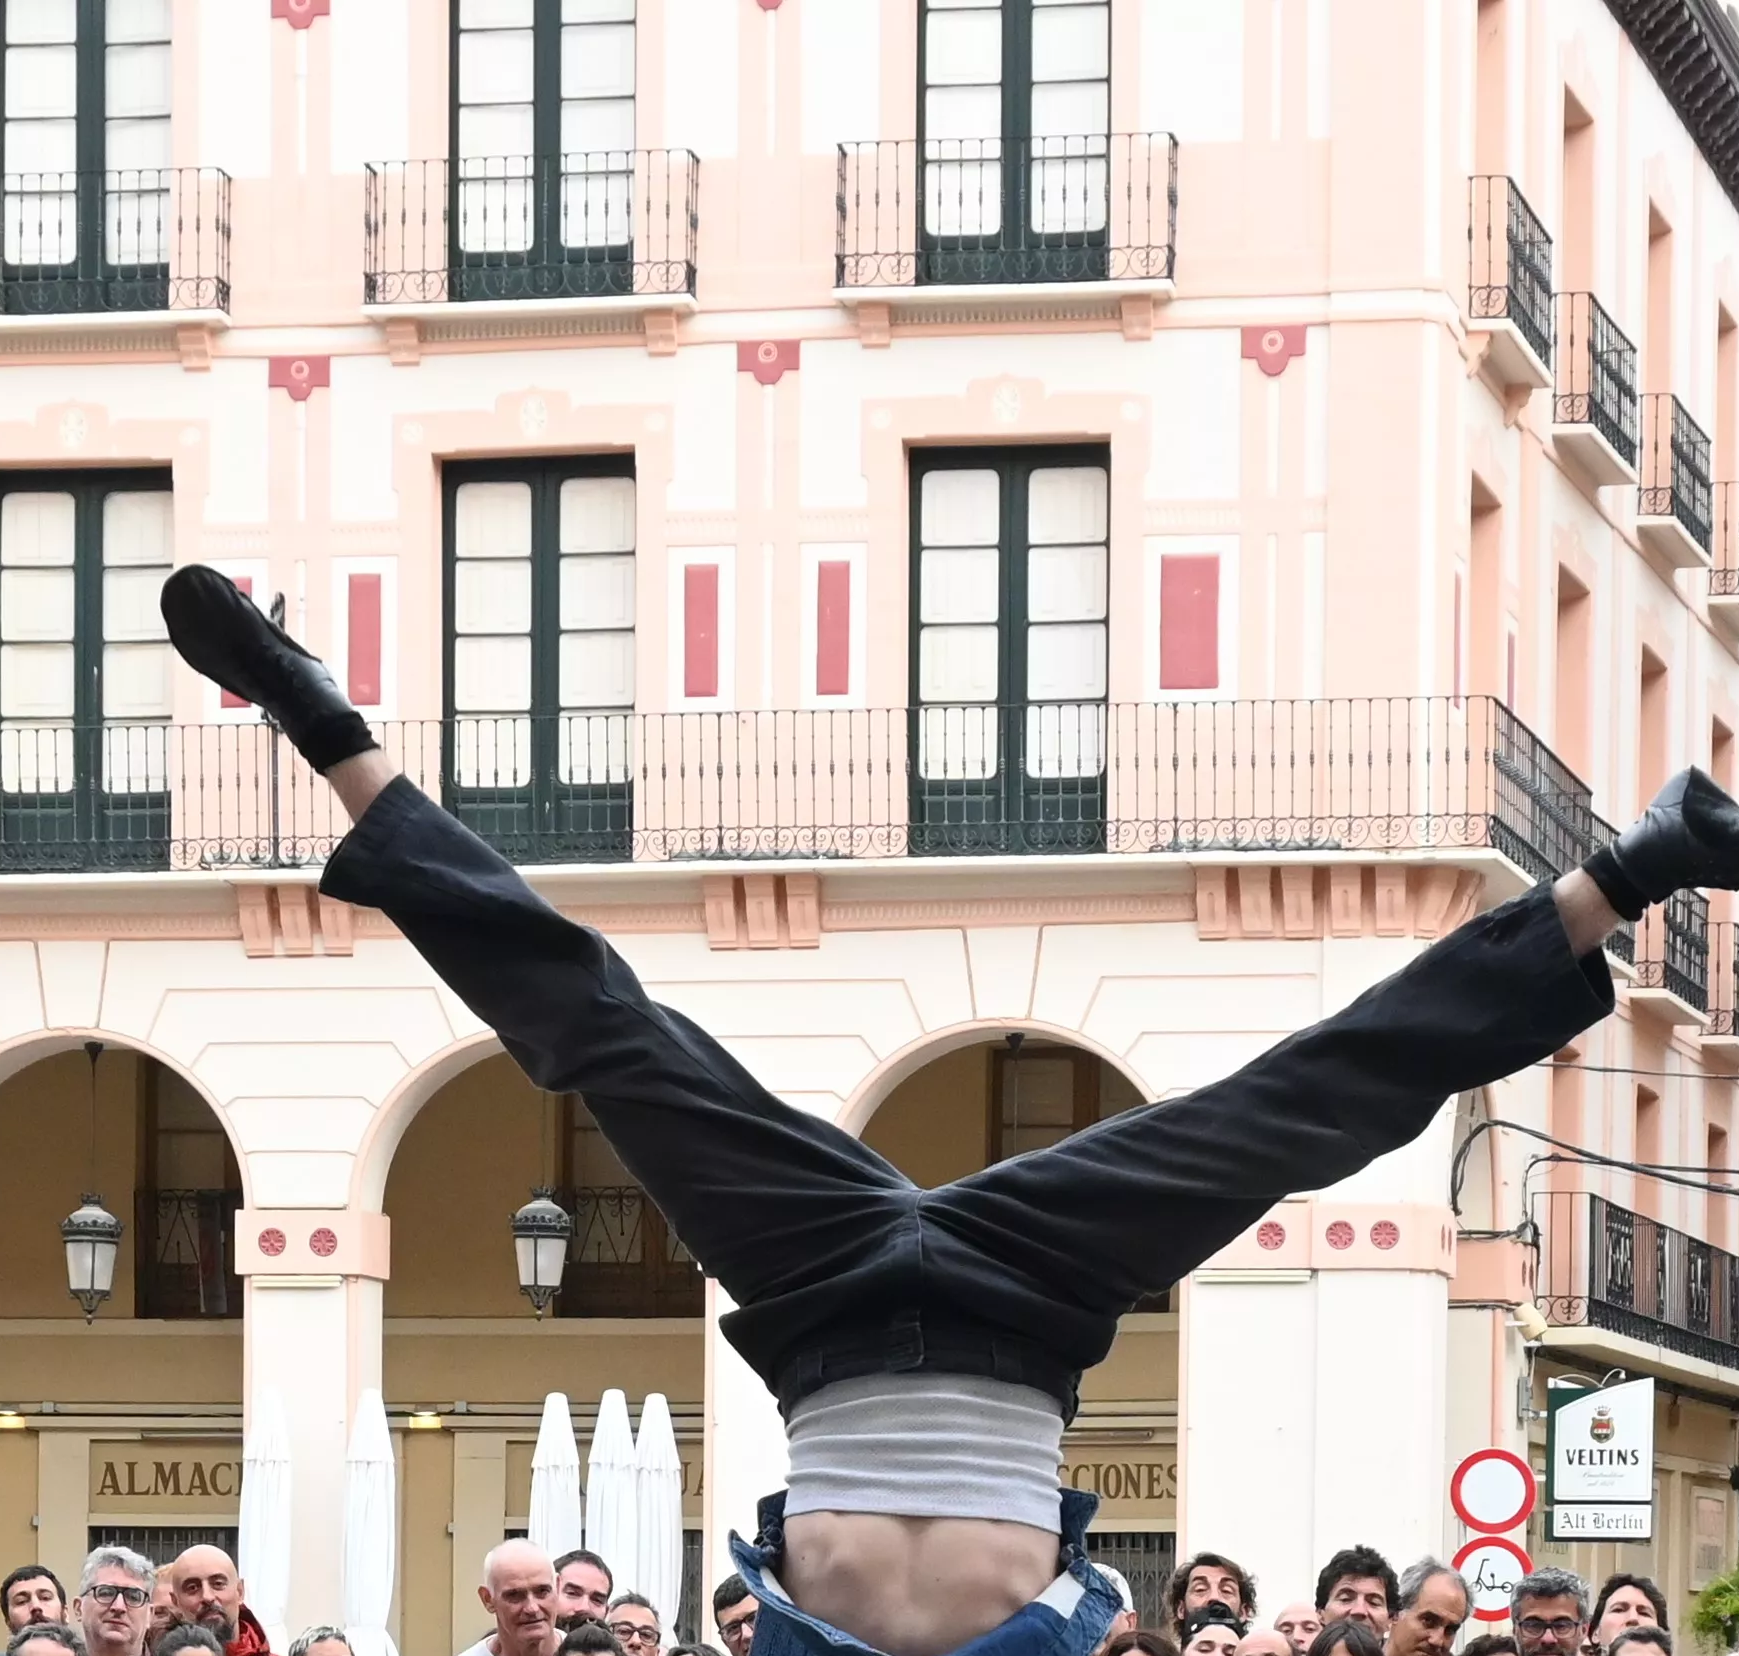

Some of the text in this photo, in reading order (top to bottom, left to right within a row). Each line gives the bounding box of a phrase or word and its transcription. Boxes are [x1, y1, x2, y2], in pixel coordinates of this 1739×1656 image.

[1565, 1448, 1639, 1466] VELTINS
[1560, 1511, 1643, 1530] Alt Berlin
